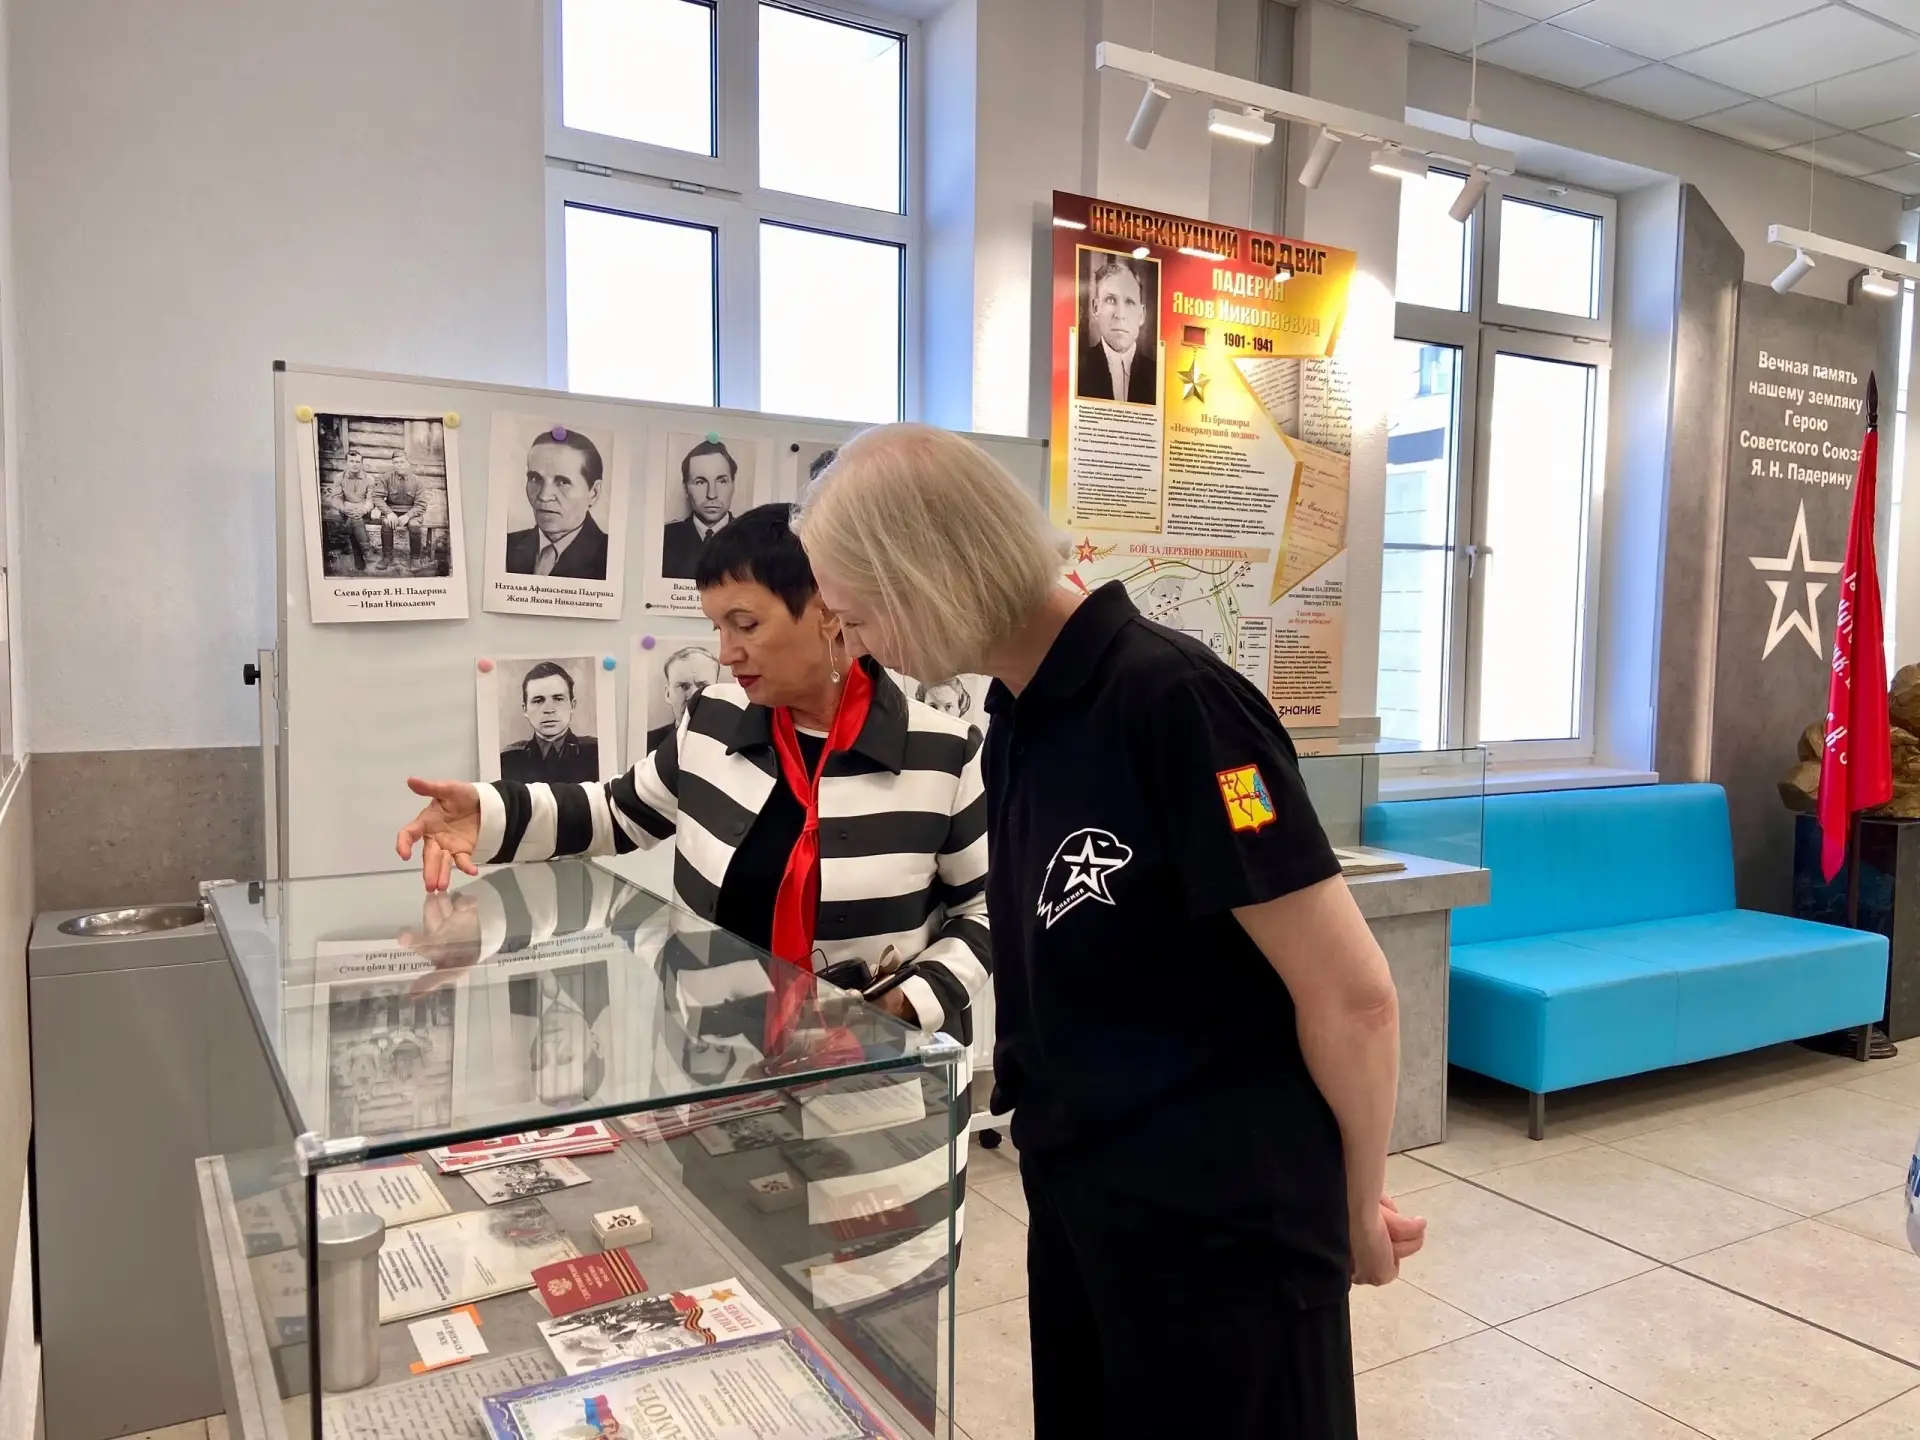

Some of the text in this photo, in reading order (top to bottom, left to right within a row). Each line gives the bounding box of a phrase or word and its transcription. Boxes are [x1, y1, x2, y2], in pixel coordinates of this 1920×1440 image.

[1091, 204, 1238, 259] НЕМЕРКНУЩИЙ
[1212, 268, 1286, 302] ПАДЕРИН
[1173, 291, 1320, 337] Яков Николаевич
[1224, 332, 1245, 348] 1901
[1253, 337, 1273, 353] 1941
[1759, 350, 1858, 385] Вечная память
[1749, 381, 1863, 415] нашему земляку
[1201, 413, 1250, 428] Из брошюры
[1785, 409, 1828, 432] Герою
[1740, 430, 1818, 456] Советского
[1751, 459, 1852, 490] Я. Н. Падерину
[1129, 544, 1248, 559] БОЙ ЗА ДЕРЕВНЮ РЯБИНИХА
[334, 587, 447, 598] Слева брат Я. Н. Падерина
[495, 582, 614, 599] Наталья Афанасьевна Падерина
[506, 594, 603, 608] Жена Якова Николаевича
[671, 593, 687, 601] Сын
[360, 600, 384, 609] Иван
[385, 599, 436, 608] Николаевич
[1054, 888, 1085, 913] ЮНАРМИЯ
